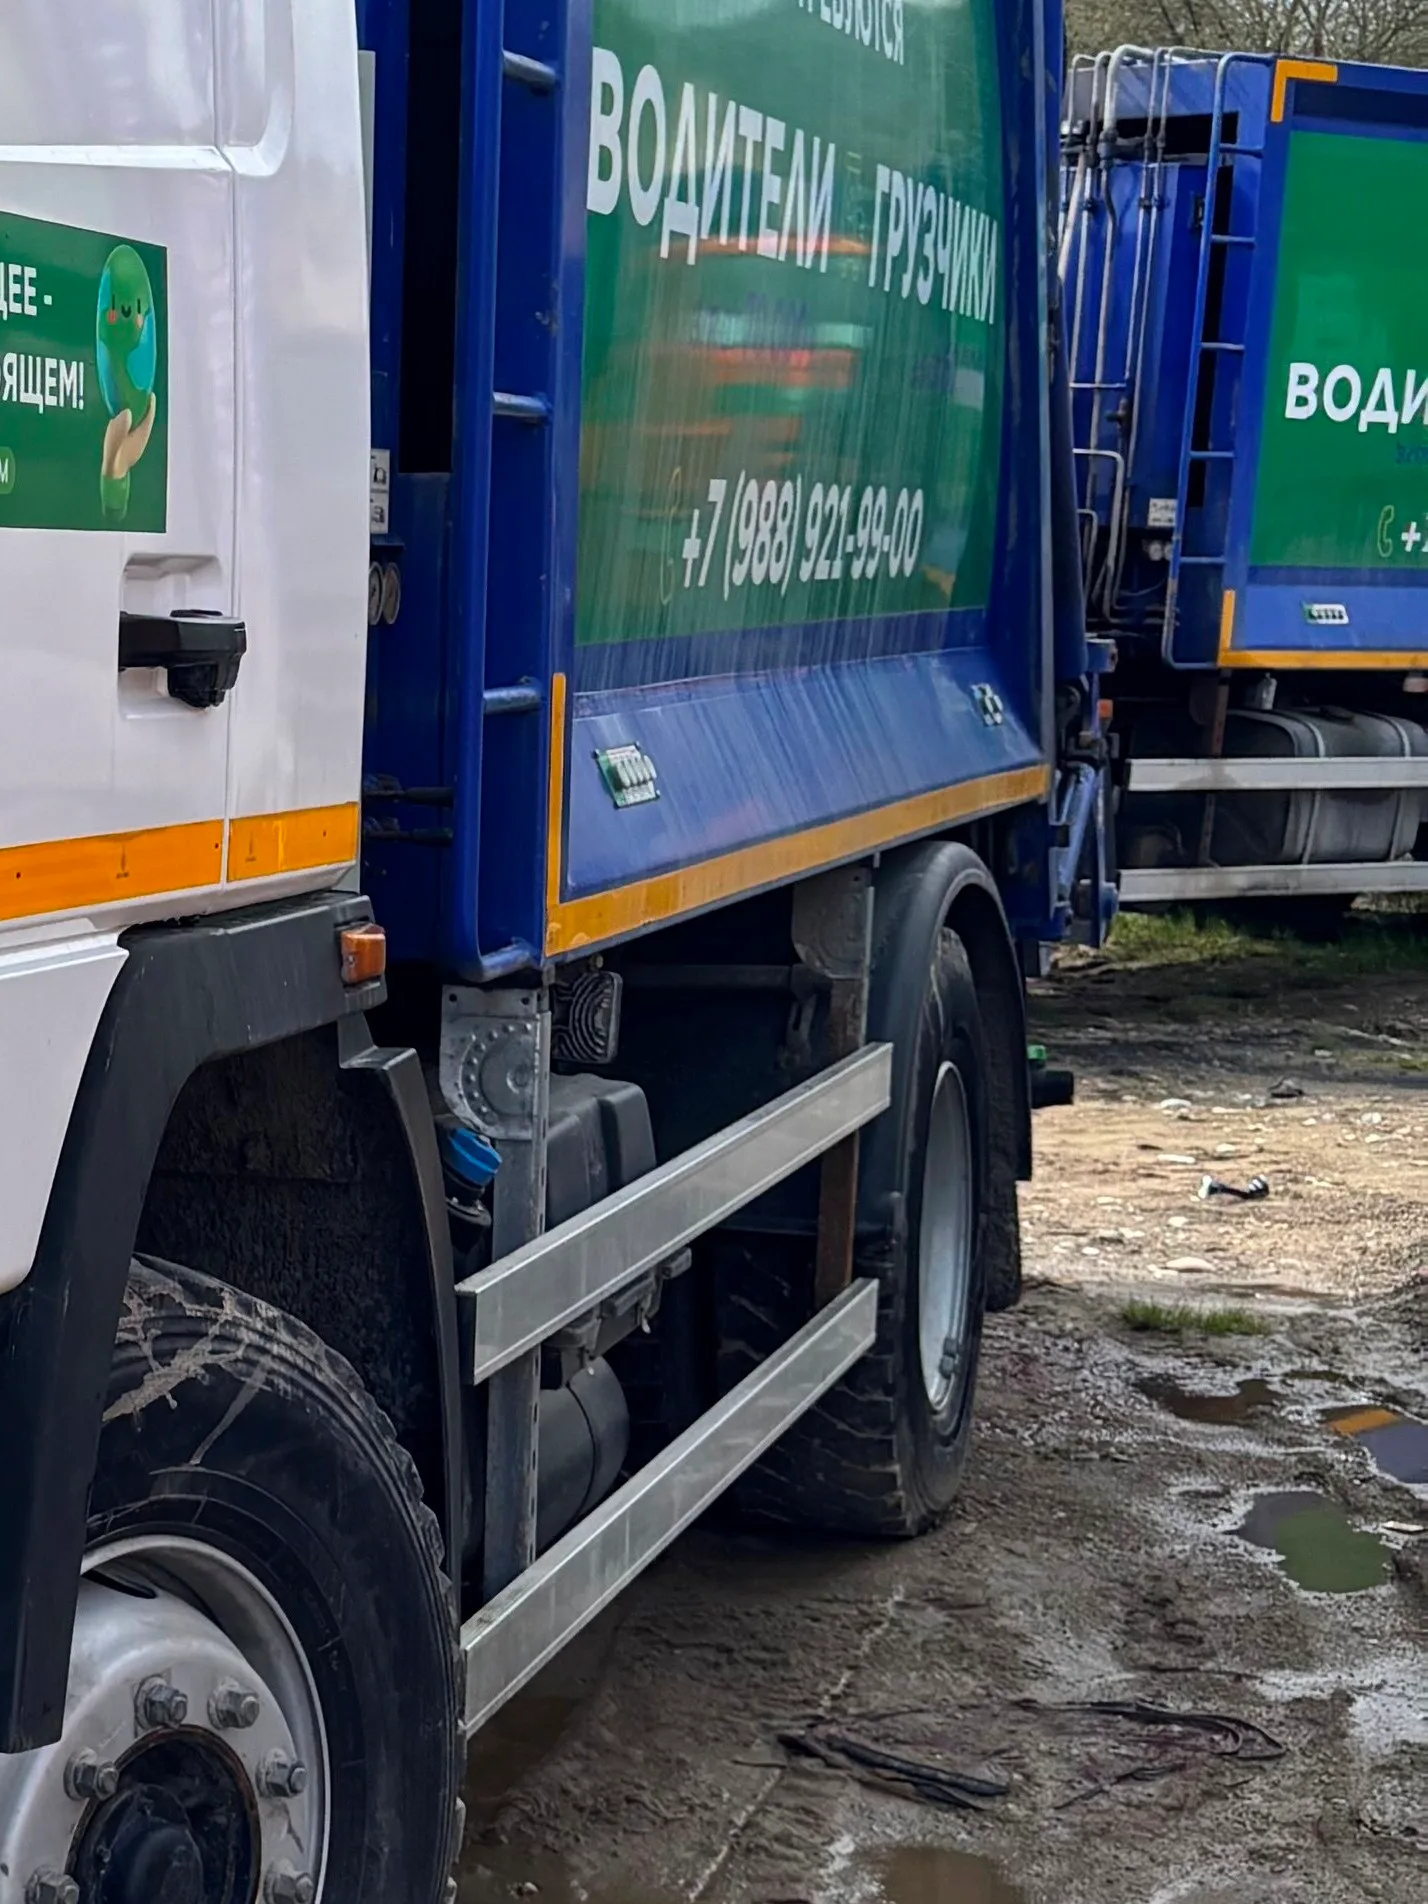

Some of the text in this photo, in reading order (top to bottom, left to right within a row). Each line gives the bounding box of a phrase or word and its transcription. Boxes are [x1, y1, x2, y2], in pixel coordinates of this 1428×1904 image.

[586, 46, 999, 326] ВОДИТЕЛИ ГРУЗЧИКИ
[681, 469, 924, 601] +7 (988) 921-99-00
